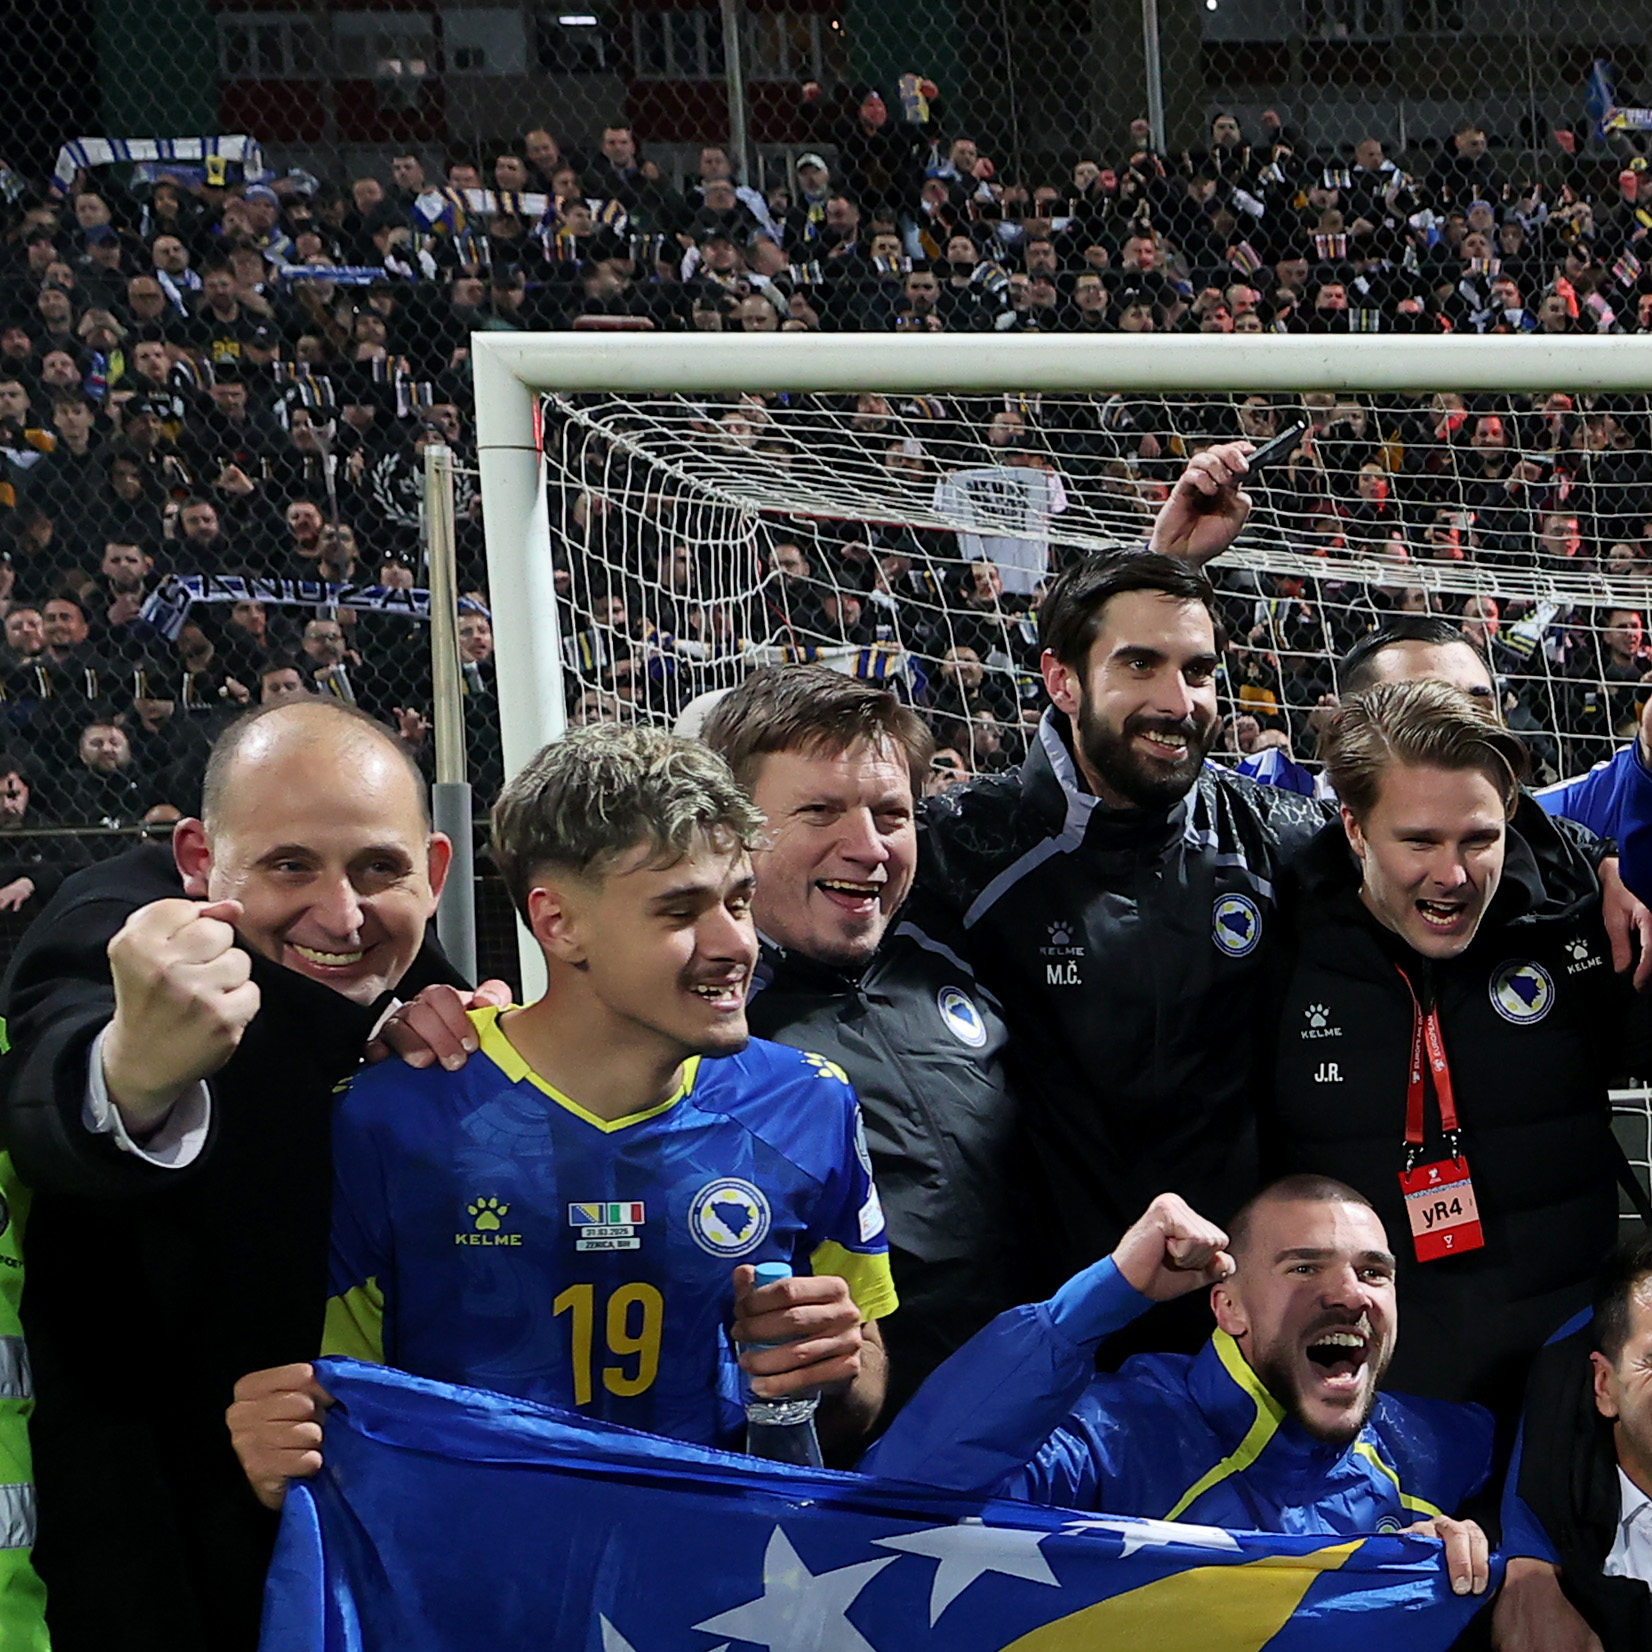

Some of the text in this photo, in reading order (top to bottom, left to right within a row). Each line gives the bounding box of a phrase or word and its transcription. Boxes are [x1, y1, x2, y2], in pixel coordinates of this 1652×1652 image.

[1040, 947, 1085, 957] KELME
[1046, 960, 1082, 984] M.Č.
[1567, 956, 1603, 975] KELME
[1301, 1027, 1343, 1039] KELME
[1314, 1063, 1344, 1083] J.R.
[1422, 1201, 1463, 1228] yR4
[455, 1234, 522, 1246] KELME
[553, 1283, 664, 1407] 19
